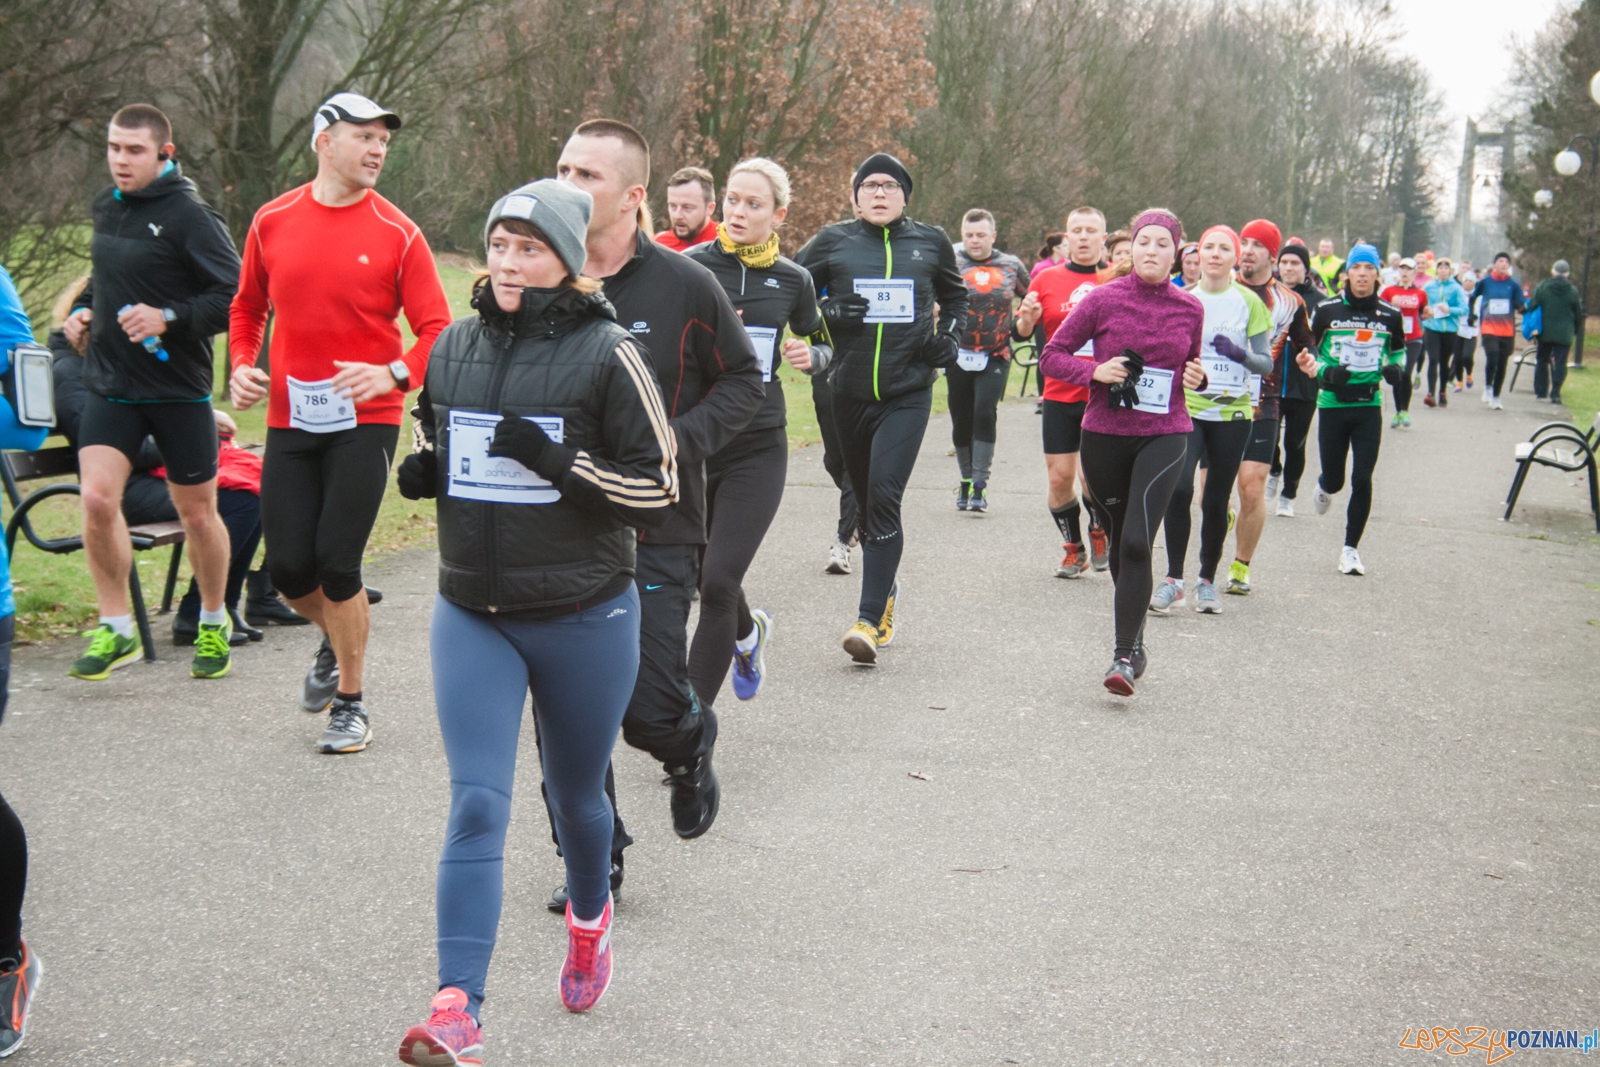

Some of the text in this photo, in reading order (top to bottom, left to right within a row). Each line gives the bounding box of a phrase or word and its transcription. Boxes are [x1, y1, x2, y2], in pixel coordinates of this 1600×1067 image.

[877, 291, 891, 301] 83
[1213, 363, 1229, 372] 415
[1136, 377, 1155, 389] 32
[303, 393, 328, 406] 786
[485, 469, 522, 478] parkrun
